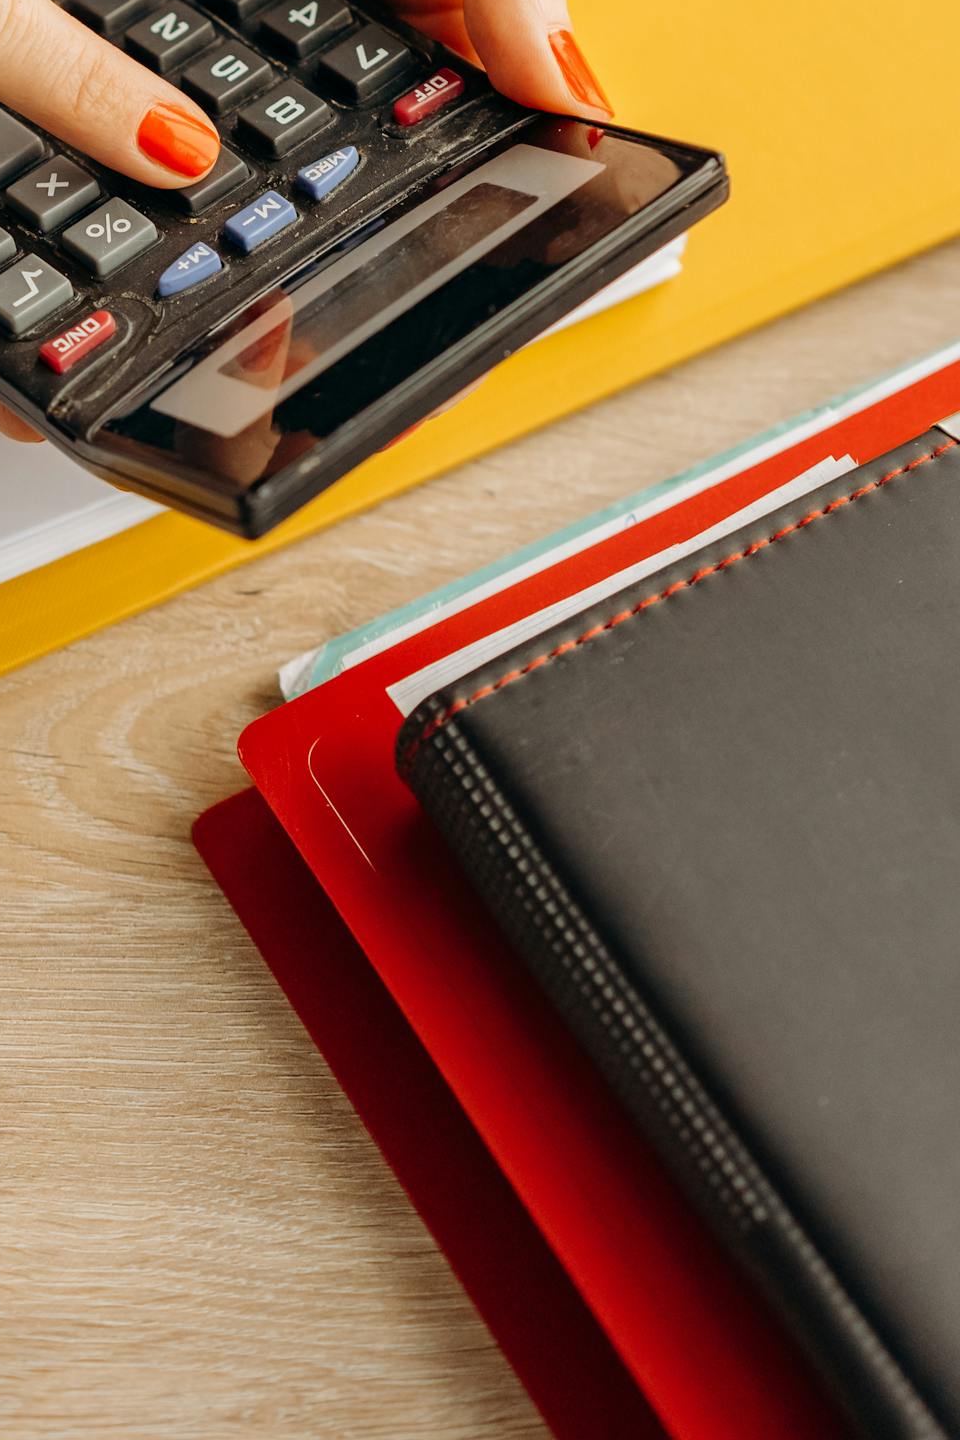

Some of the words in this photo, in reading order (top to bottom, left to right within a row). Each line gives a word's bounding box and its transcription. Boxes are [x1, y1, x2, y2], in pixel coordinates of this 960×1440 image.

[150, 12, 190, 41] 2
[288, 0, 320, 28] 4
[210, 54, 249, 82] 5
[355, 43, 389, 70] 7
[413, 74, 449, 103] OFF
[265, 95, 306, 125] 8
[304, 150, 347, 182] MRC
[85, 212, 132, 244] %
[177, 246, 212, 272] M+
[52, 317, 101, 354] ON/C
